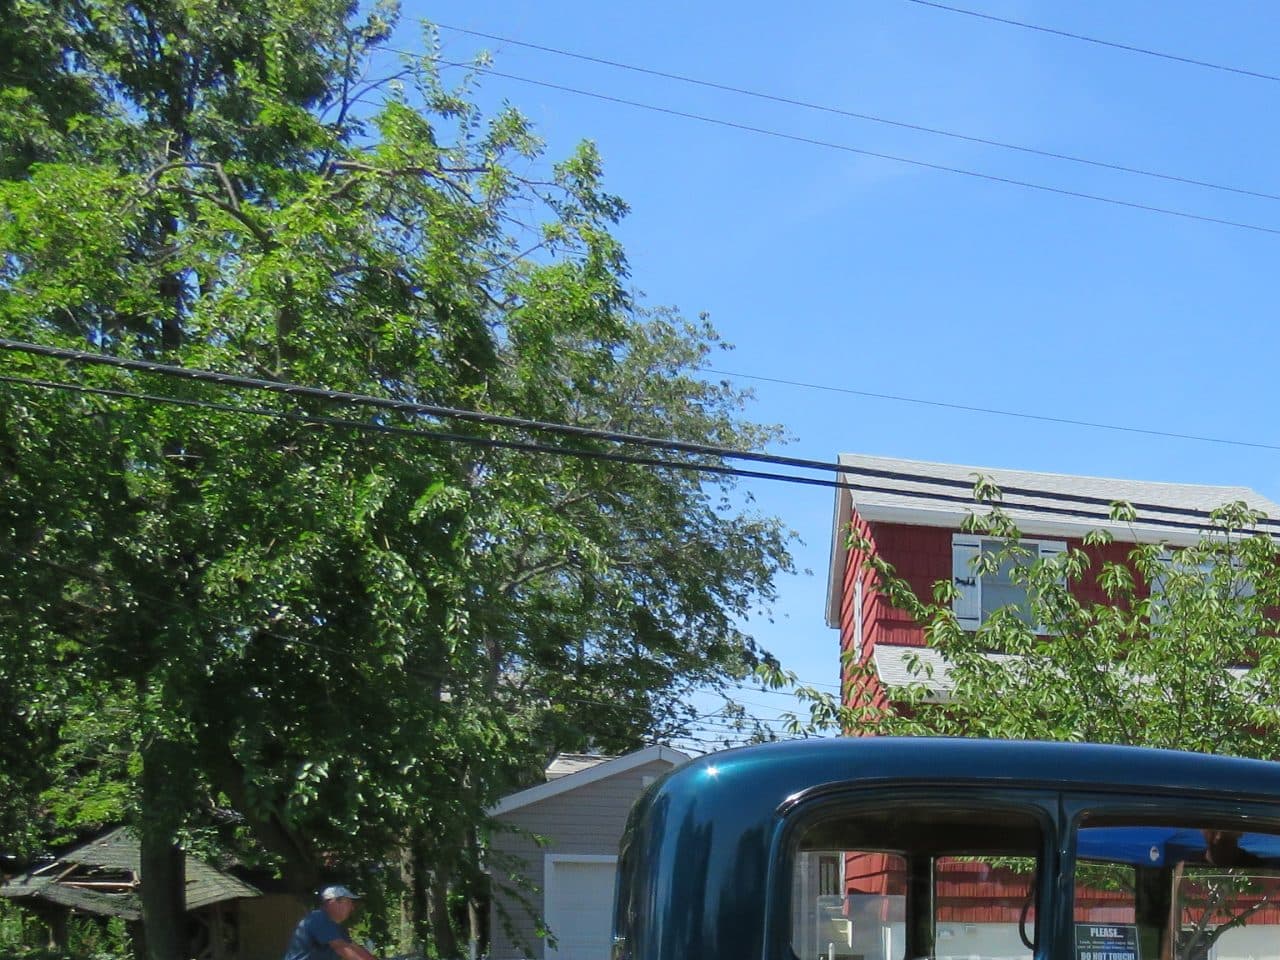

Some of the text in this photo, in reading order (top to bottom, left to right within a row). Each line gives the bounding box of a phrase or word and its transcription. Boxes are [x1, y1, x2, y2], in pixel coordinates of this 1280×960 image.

[1080, 952, 1135, 960] DO NOT TOUCH!
